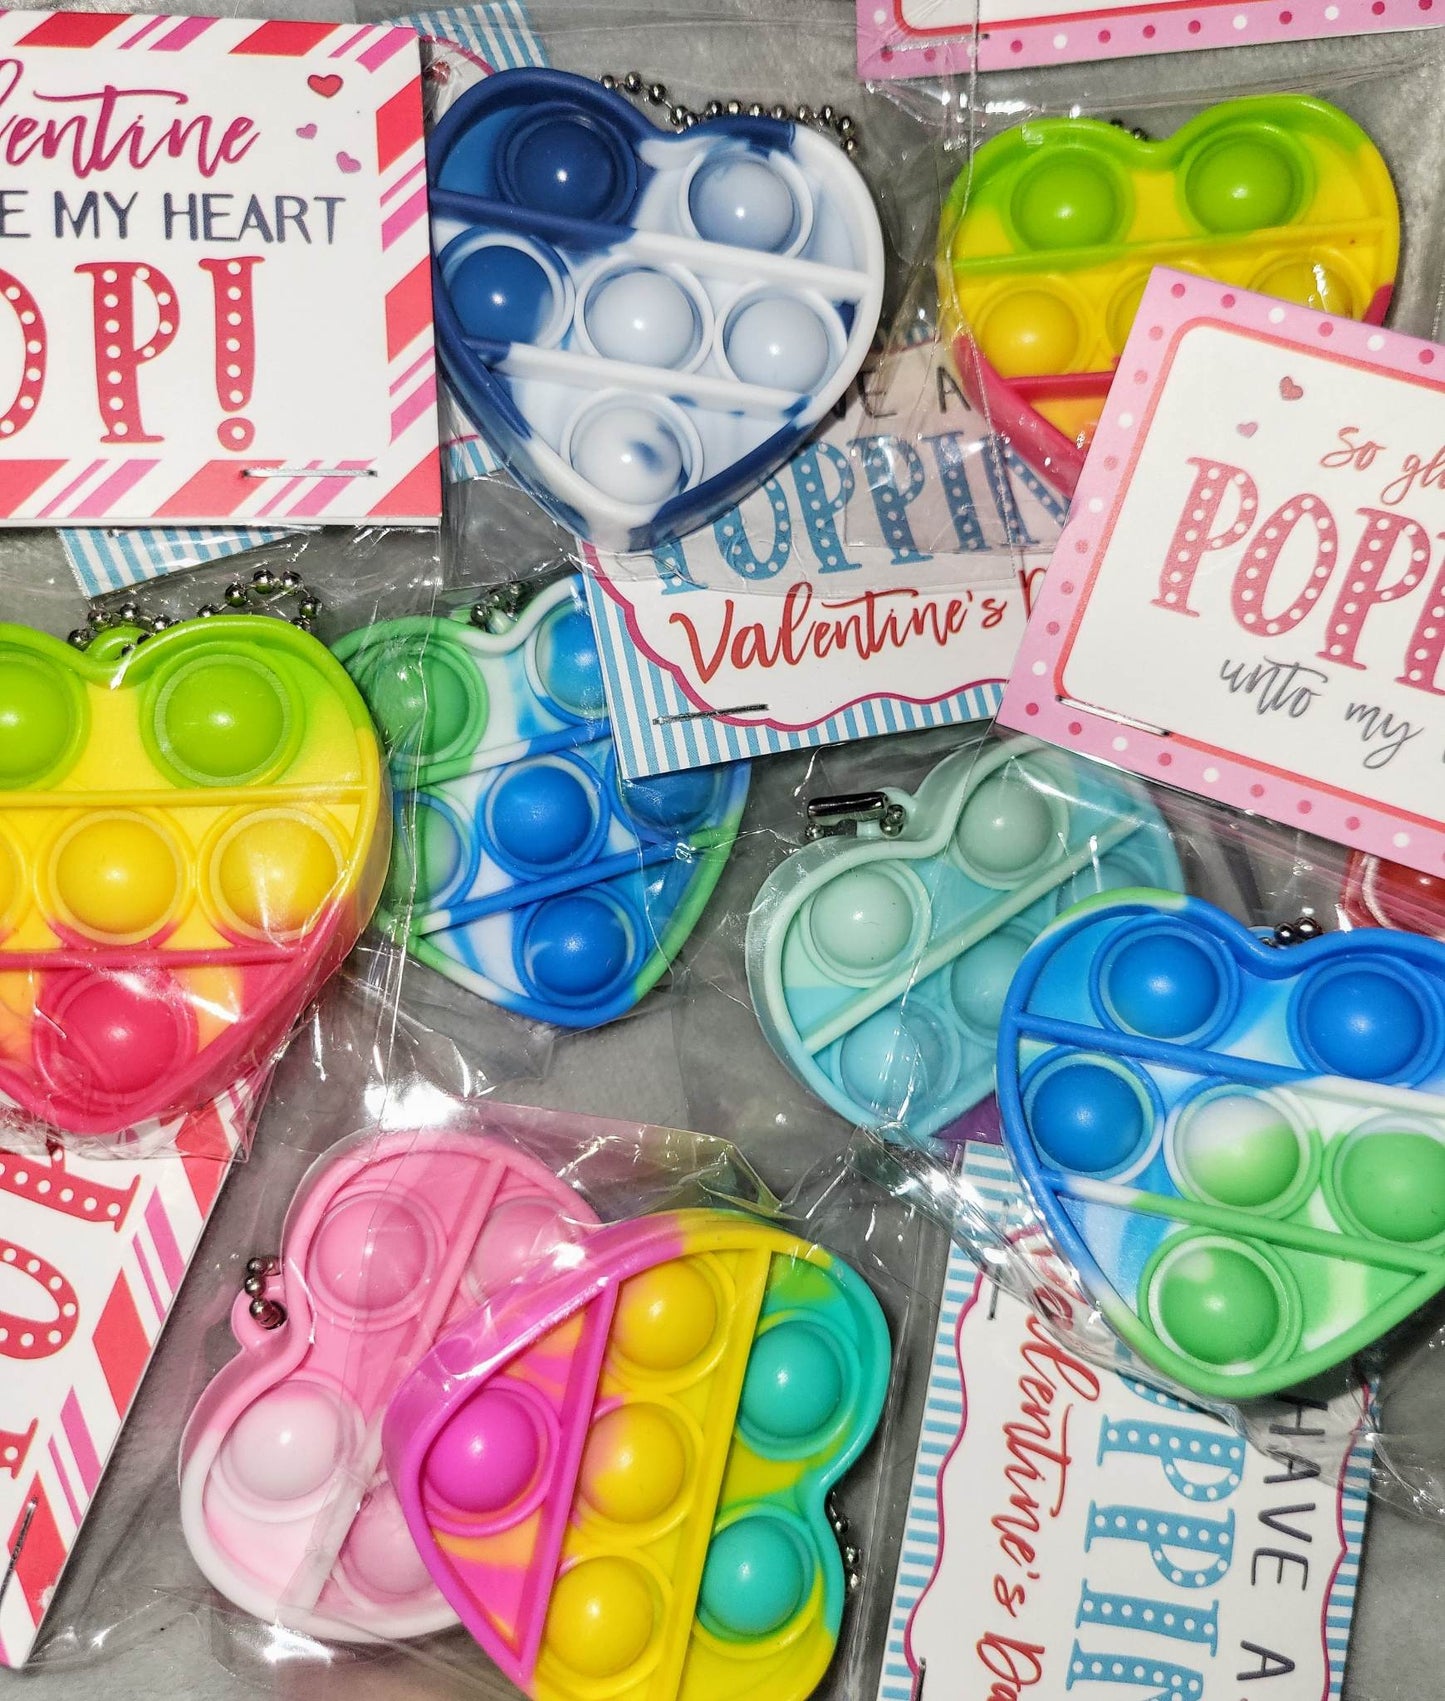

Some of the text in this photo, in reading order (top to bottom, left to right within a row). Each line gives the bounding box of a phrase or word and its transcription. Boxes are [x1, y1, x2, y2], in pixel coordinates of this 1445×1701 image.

[54, 190, 138, 240] MY
[163, 192, 347, 245] HEART
[936, 366, 971, 413] A
[1319, 426, 1386, 472] So
[668, 581, 1007, 685] Valentine's
[1219, 655, 1425, 770] unto my
[1236, 1395, 1329, 1682] HAVE A
